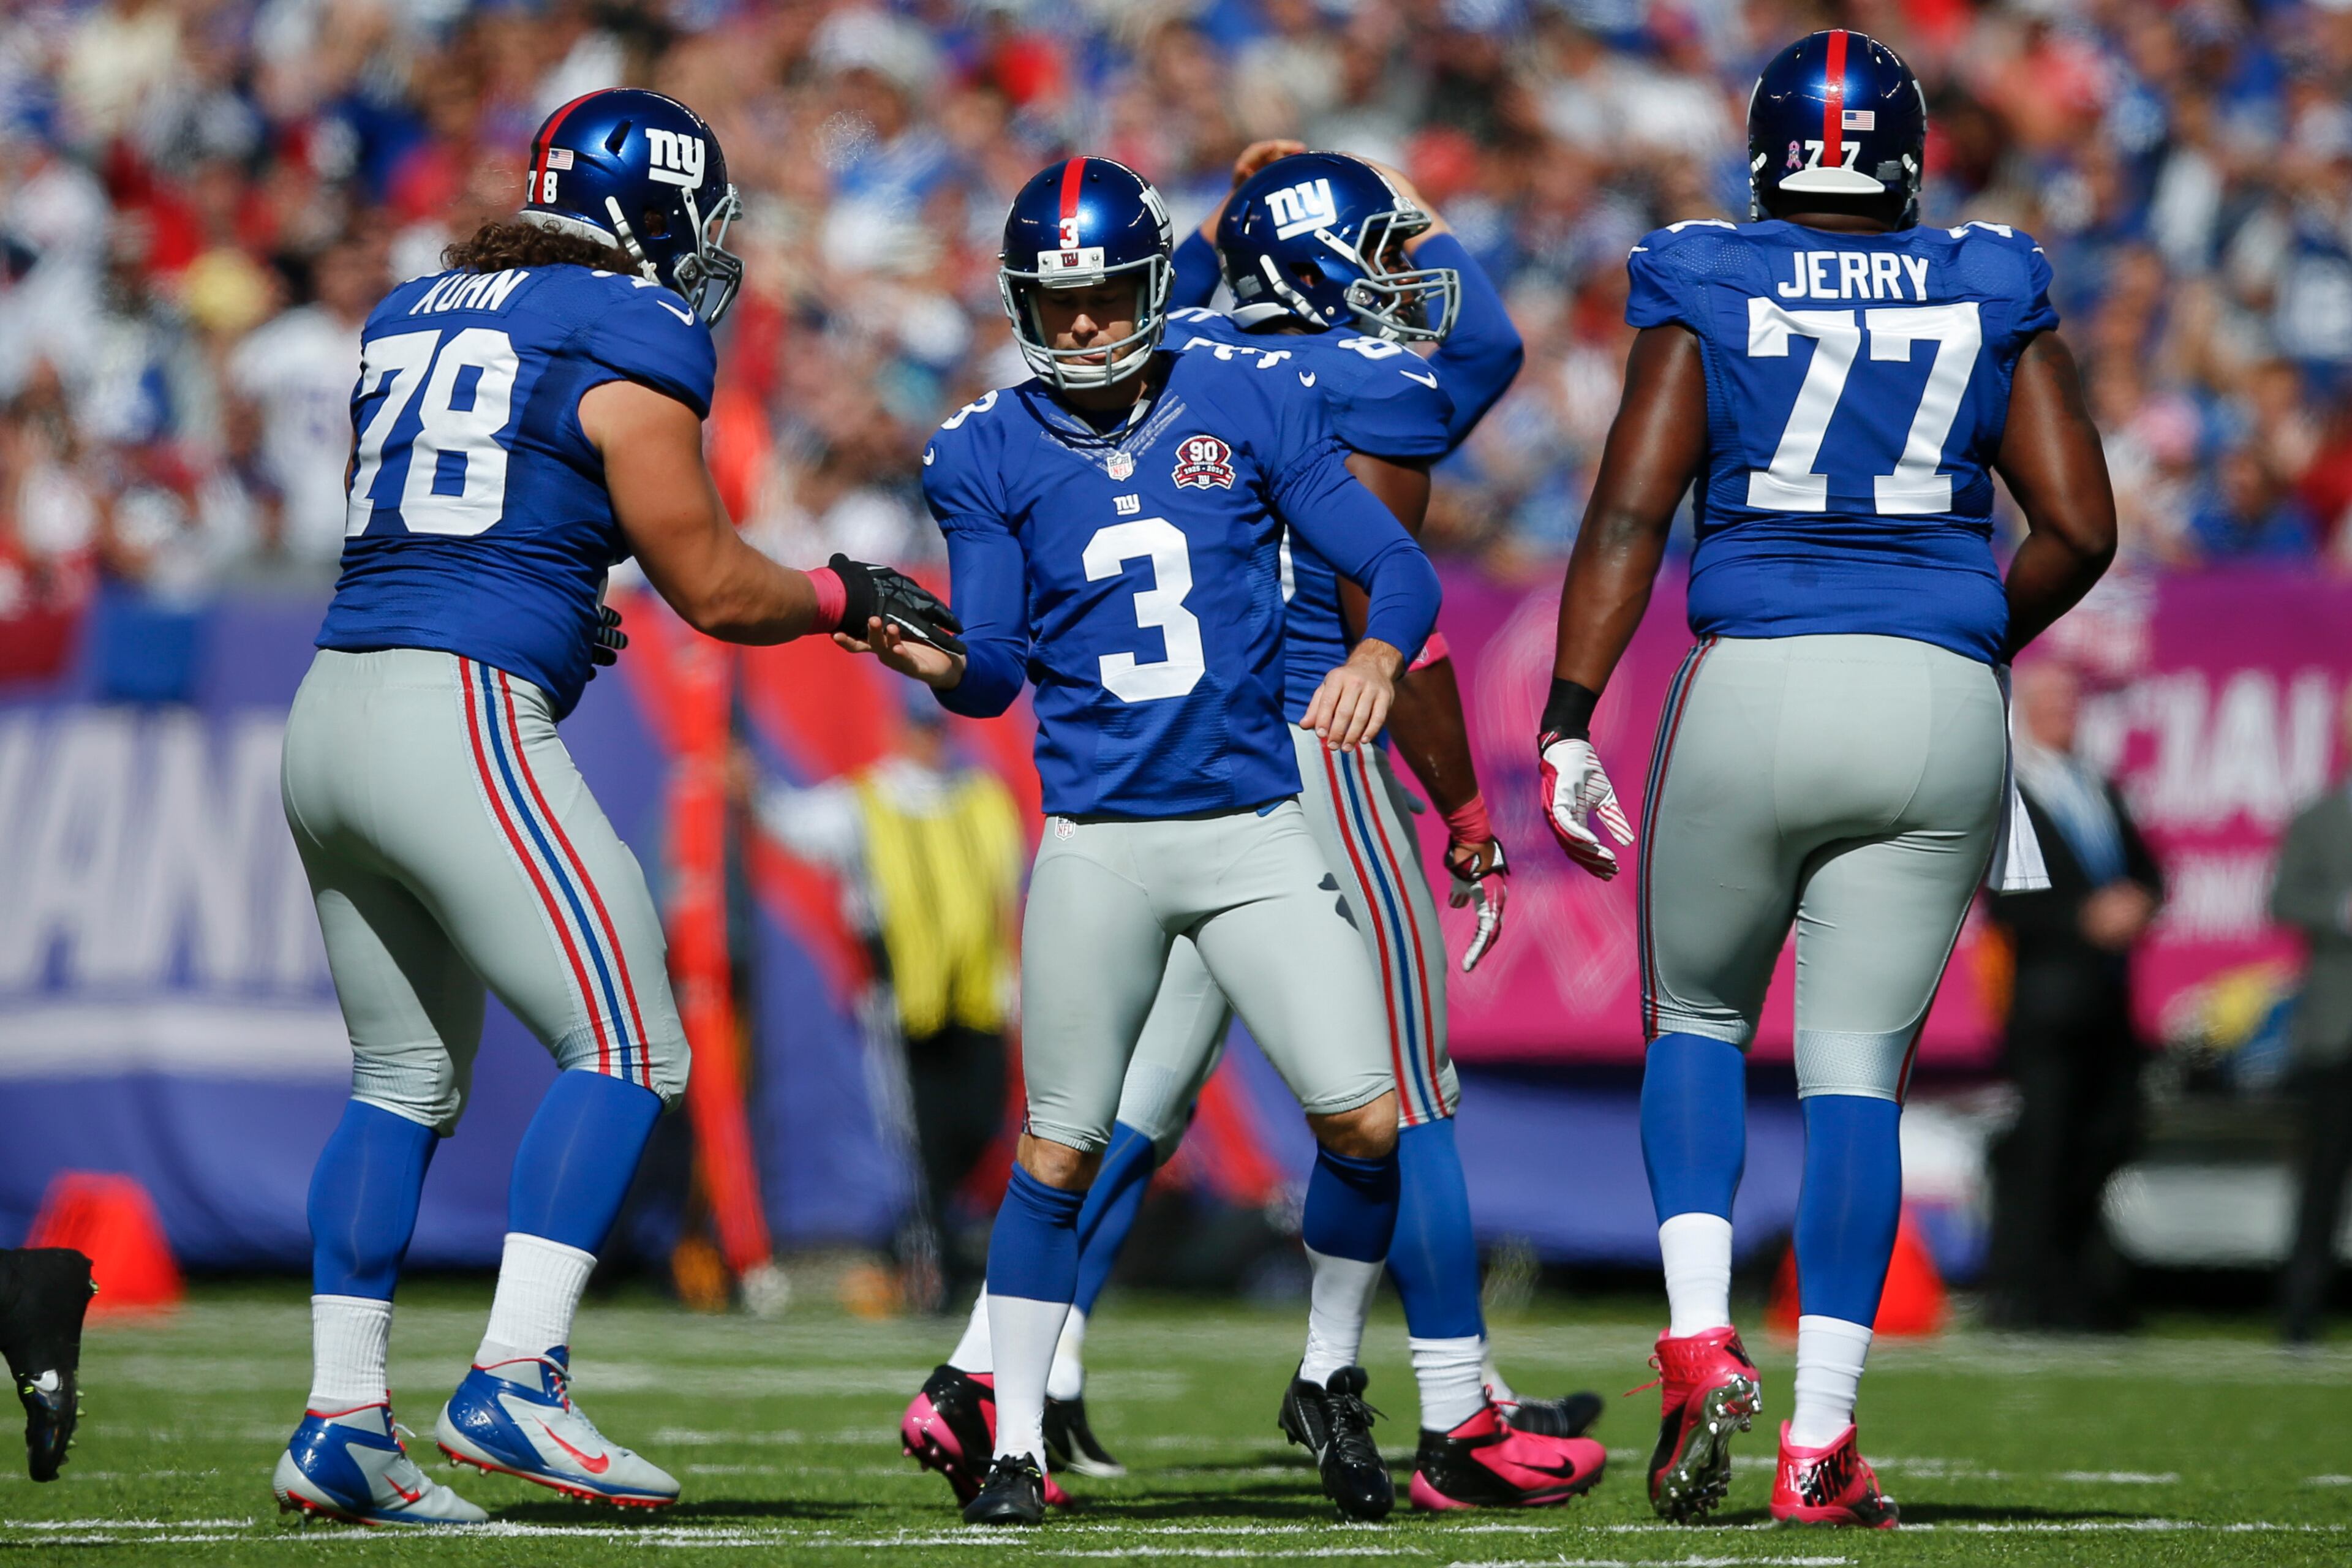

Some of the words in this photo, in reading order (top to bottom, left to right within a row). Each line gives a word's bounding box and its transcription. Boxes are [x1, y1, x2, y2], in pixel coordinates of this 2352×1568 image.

[1804, 140, 1861, 170] 77
[527, 170, 558, 204] 78
[1060, 217, 1079, 249] 3
[1777, 251, 1930, 301] JERRY
[1746, 297, 1983, 515] 77
[344, 327, 520, 538] 78
[1189, 441, 1218, 462] 90
[1112, 464, 1128, 477] NFL
[1081, 517, 1207, 704] 3
